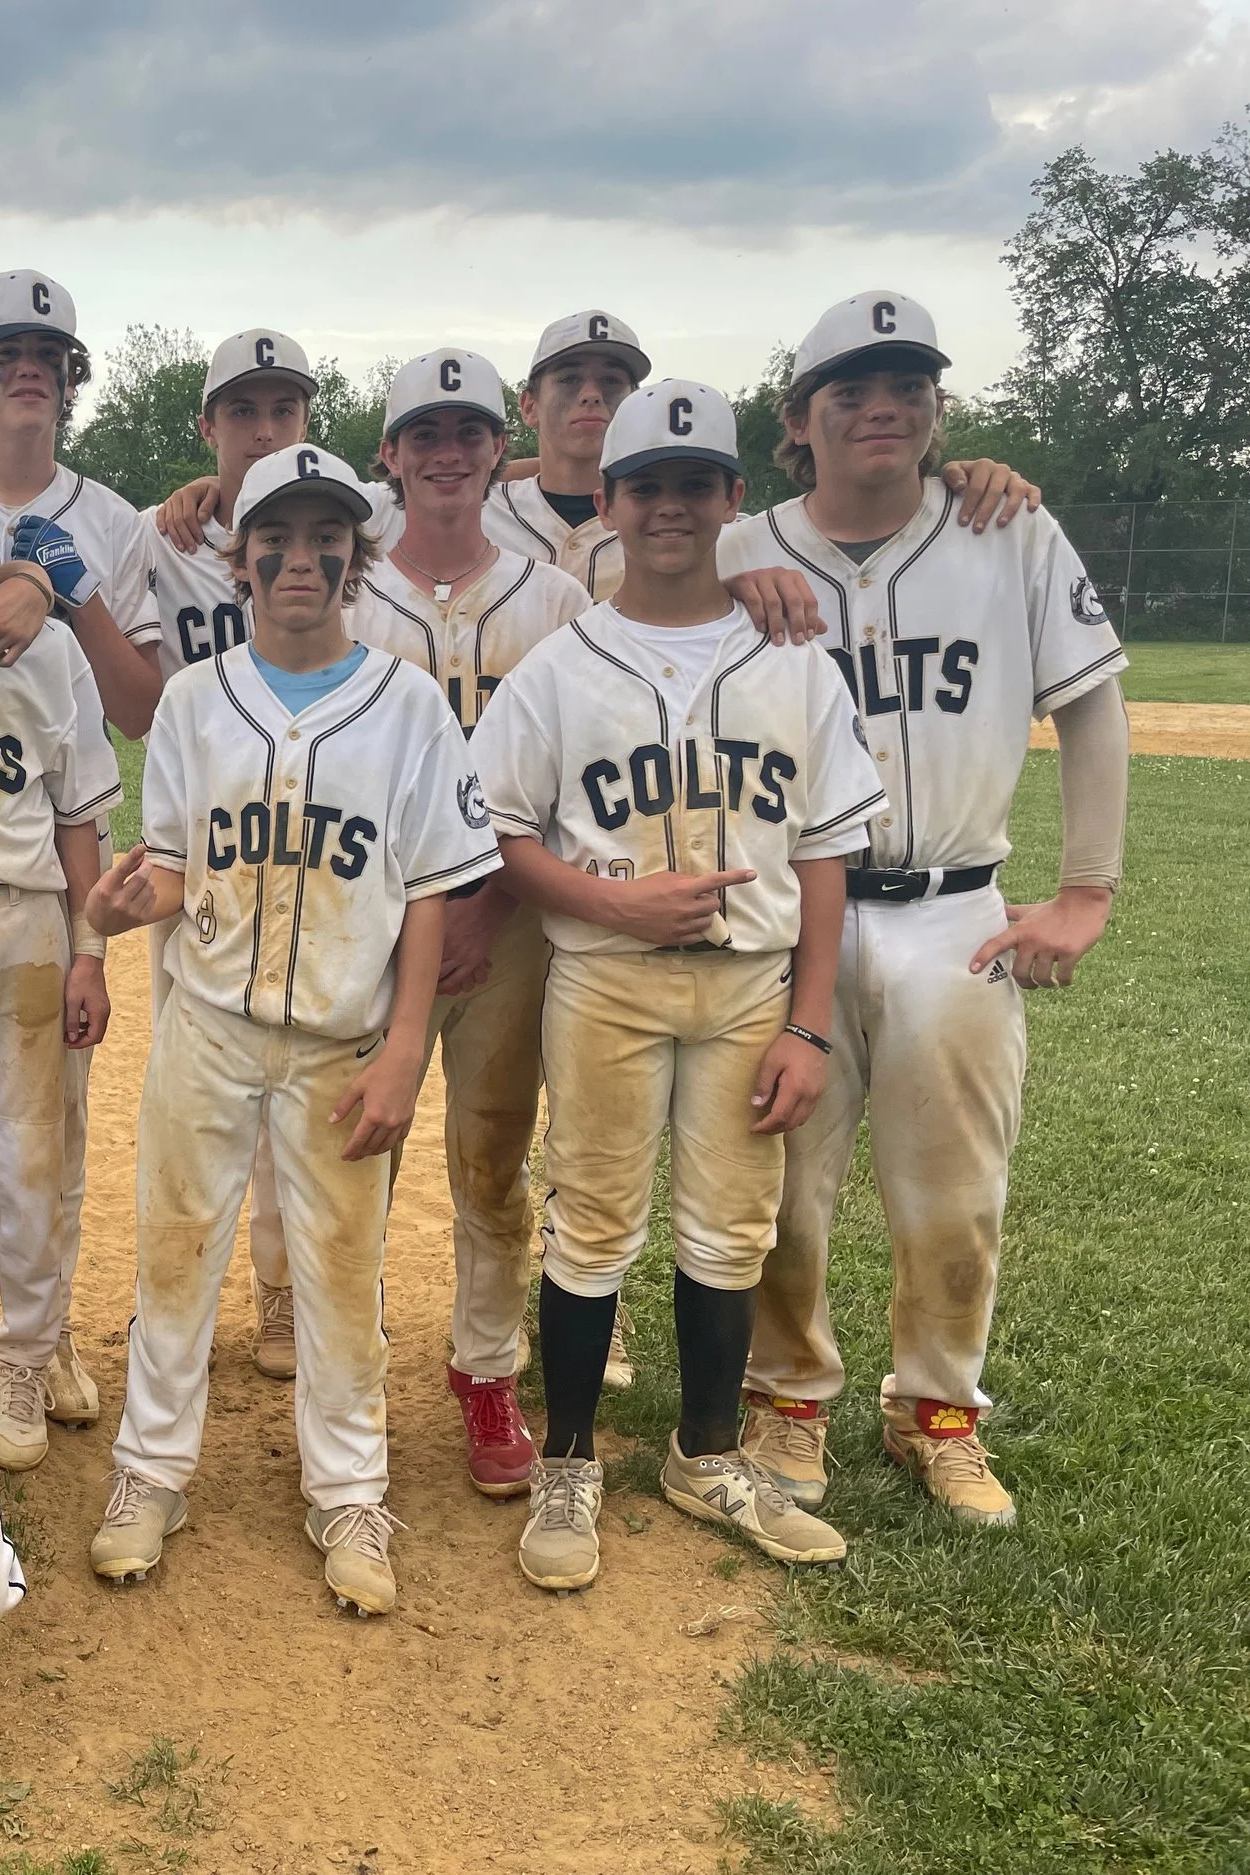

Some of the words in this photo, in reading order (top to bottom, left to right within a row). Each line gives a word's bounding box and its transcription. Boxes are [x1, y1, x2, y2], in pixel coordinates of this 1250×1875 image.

[32, 283, 50, 315] C
[589, 315, 608, 339] C
[873, 301, 895, 333] C
[256, 338, 274, 366] C
[440, 359, 461, 391] C
[669, 398, 692, 435] C
[297, 450, 319, 479] C
[825, 637, 979, 715] LTS
[581, 738, 798, 832] COLTS
[207, 801, 378, 881] COLTS
[196, 889, 217, 944] 8
